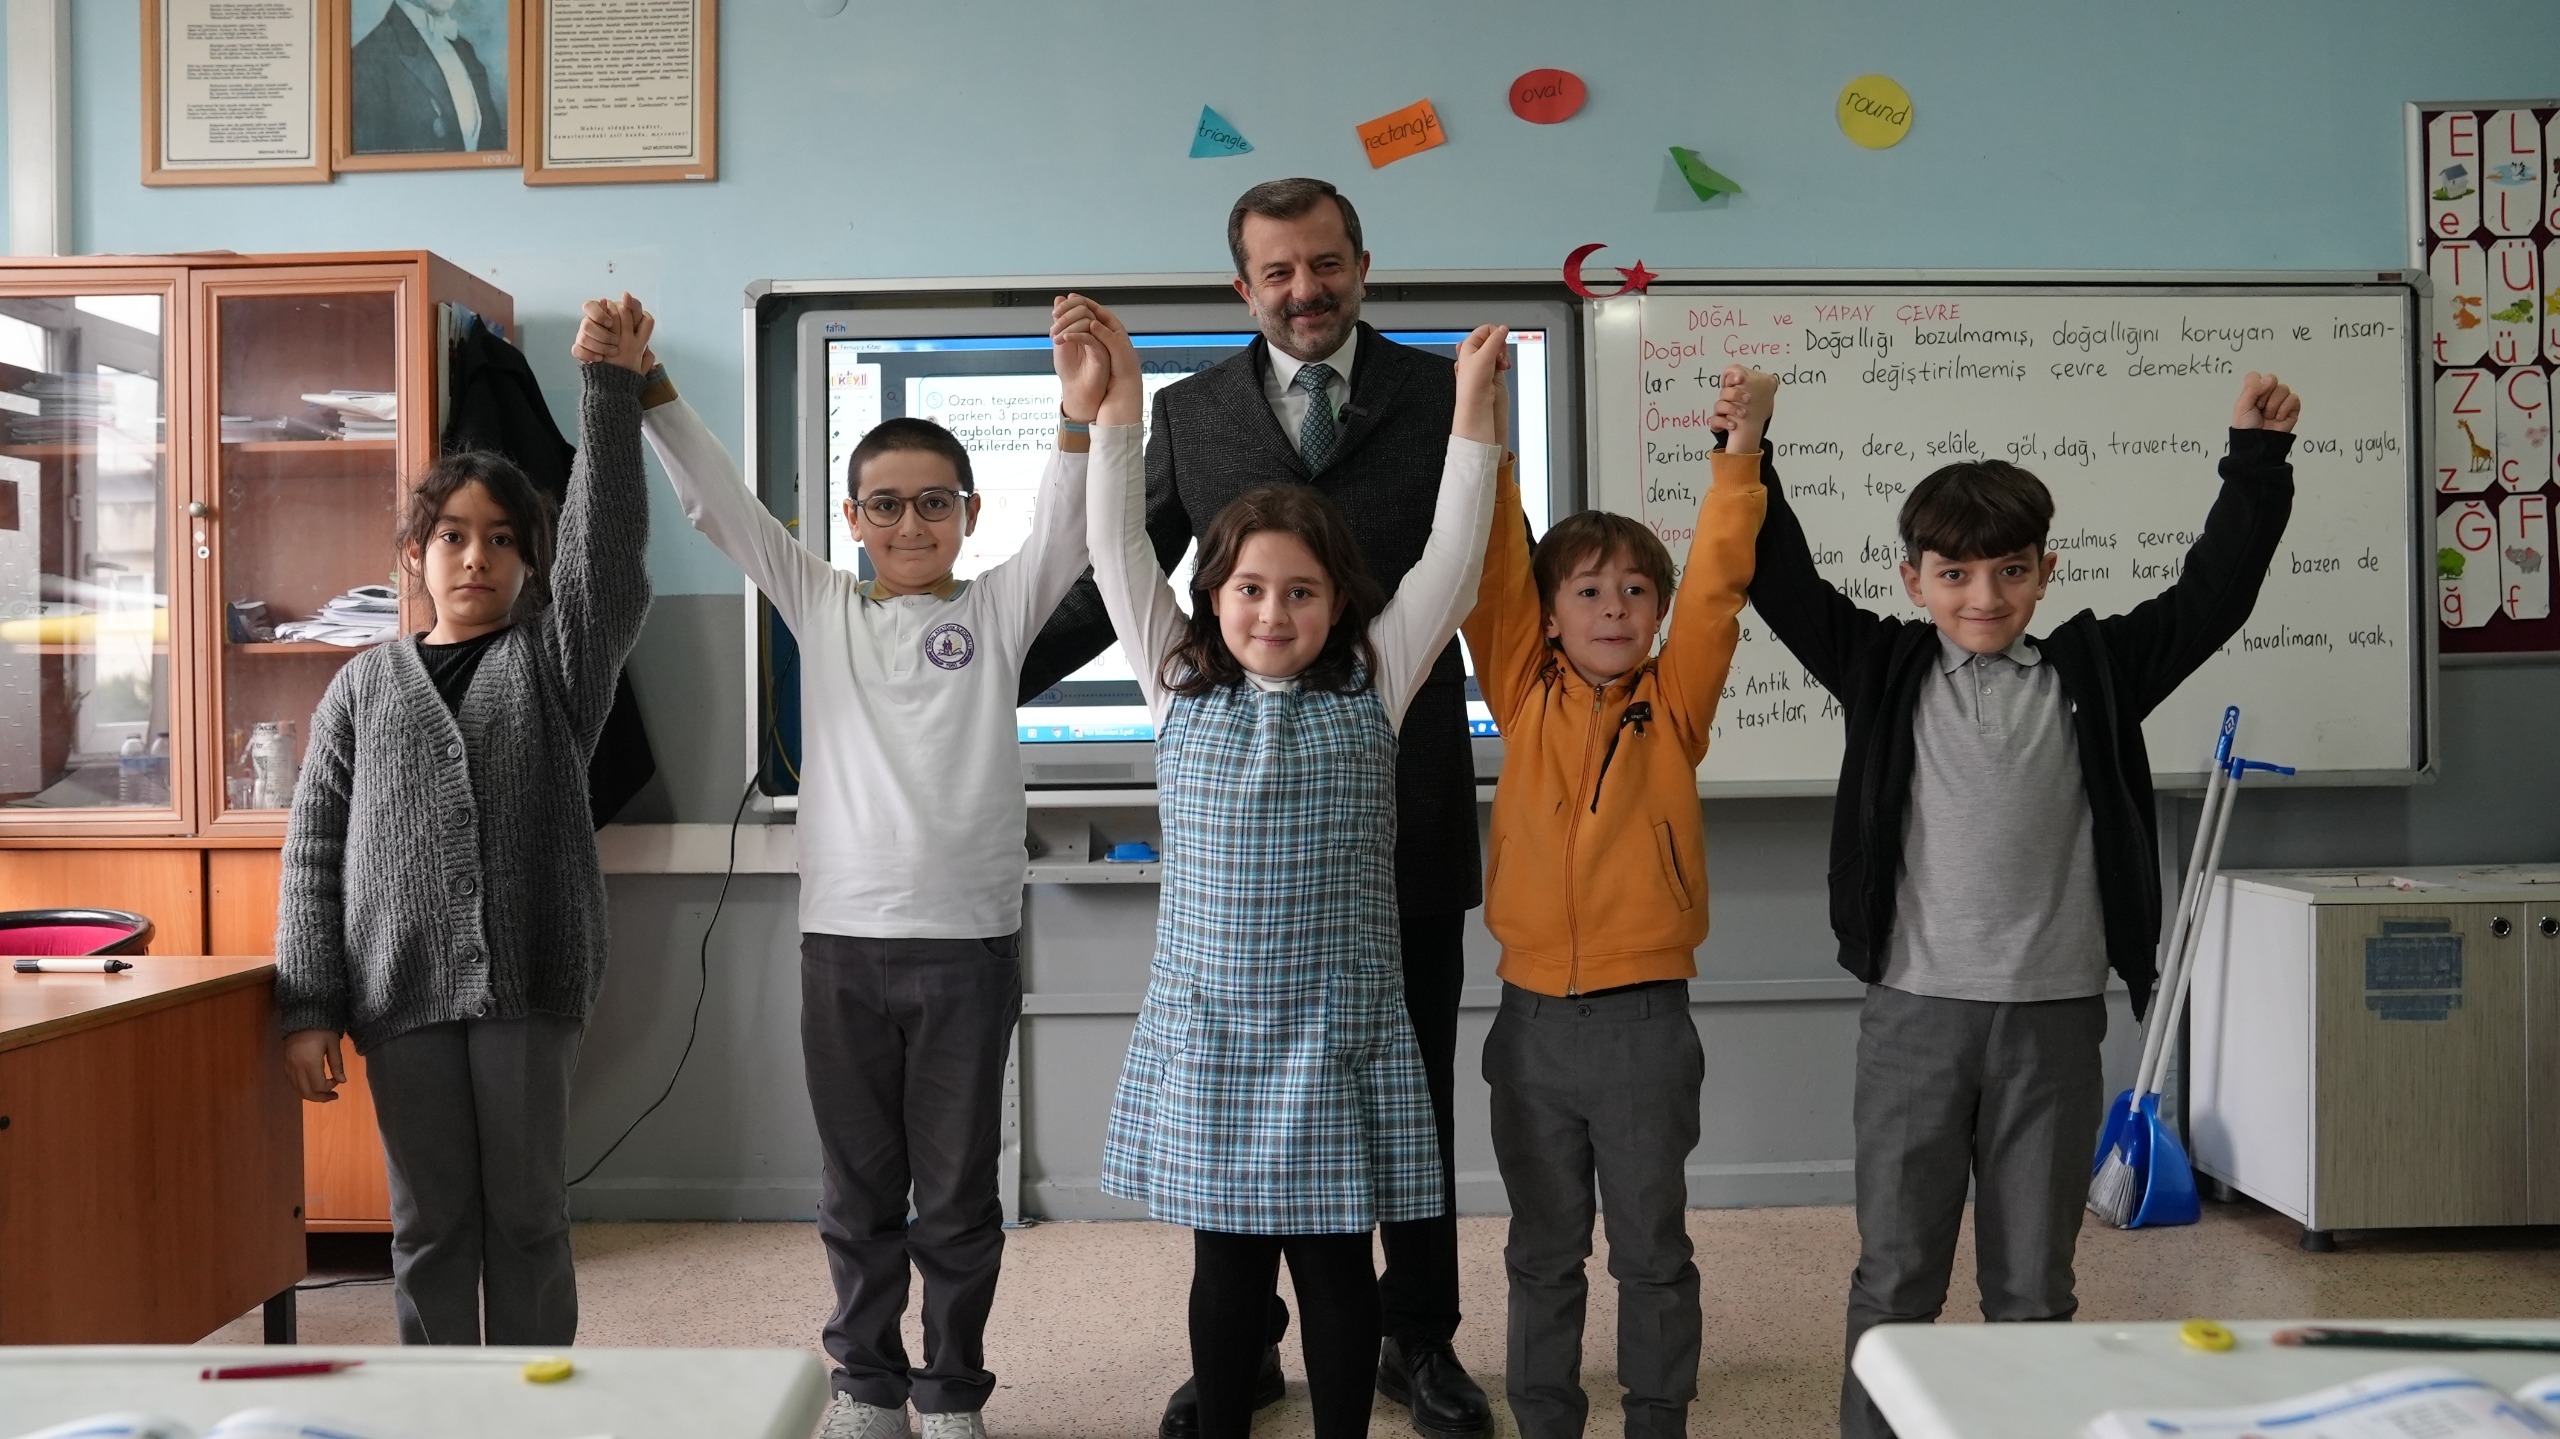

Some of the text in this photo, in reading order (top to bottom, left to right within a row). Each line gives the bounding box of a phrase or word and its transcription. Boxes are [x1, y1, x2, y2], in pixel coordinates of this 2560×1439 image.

[1521, 78, 1564, 103] oval
[1846, 92, 1910, 126] round
[1199, 120, 1248, 151] triangle
[1364, 109, 1437, 150] rectangle
[2450, 116, 2474, 157] E
[2511, 113, 2535, 154] L
[2440, 212, 2460, 235] e
[2442, 244, 2471, 286] T
[2501, 241, 2534, 291] Ü
[1688, 303, 1961, 331] DOĞAL ve YAPAY ÇEVRE
[1644, 335, 1705, 369] Doğal
[1806, 327, 1894, 359] Doğallığı
[1914, 324, 2034, 349] bozulmamış,
[2052, 320, 2160, 355] doğallığını
[2181, 316, 2275, 352] koruyan
[2292, 326, 2313, 342] ve
[2332, 316, 2395, 340] insan-
[2433, 332, 2448, 363] t
[2495, 331, 2517, 364] ü
[1645, 370, 1676, 395] lar
[1862, 356, 2027, 391] değiştirilmemiş
[2050, 361, 2107, 379] çevre
[2128, 354, 2233, 377] demektir.
[991, 395, 1054, 409] teyzesinin
[2451, 372, 2482, 414] Z
[2508, 370, 2541, 418] Ç
[948, 410, 992, 424] parken
[998, 409, 1006, 421] 3
[1012, 411, 1061, 424] parçası
[950, 424, 1059, 441] Kaybolan parçal
[964, 440, 1052, 452] dakilerden ha
[1647, 441, 1711, 465] Peribac
[1777, 441, 1844, 461] orman,
[1861, 433, 1915, 461] dere,
[1926, 429, 1985, 459] şelâle,
[2006, 433, 2047, 464] göl,
[2054, 433, 2097, 467] dağ,
[2107, 431, 2209, 460] traverten,
[2303, 438, 2343, 457] ova,
[2354, 430, 2401, 463] yayla,
[1647, 478, 1697, 507] deniz,
[1790, 475, 1845, 501] ırmak,
[2439, 468, 2460, 492] z
[2501, 459, 2520, 491] ç
[2456, 501, 2492, 551] Ğ
[2519, 497, 2543, 539] F
[1860, 535, 1908, 570] değiş
[1837, 578, 1893, 599] dıkları
[2048, 560, 2109, 586] açlarını
[2292, 551, 2340, 574] bazen
[2357, 547, 2379, 572] de
[2444, 586, 2464, 627] ğ
[2506, 585, 2521, 618] f
[2243, 624, 2333, 653] havalimanı,
[2349, 624, 2393, 648] uçak,
[1745, 670, 1790, 696] Antik
[1737, 699, 1807, 729] taşıtlar,
